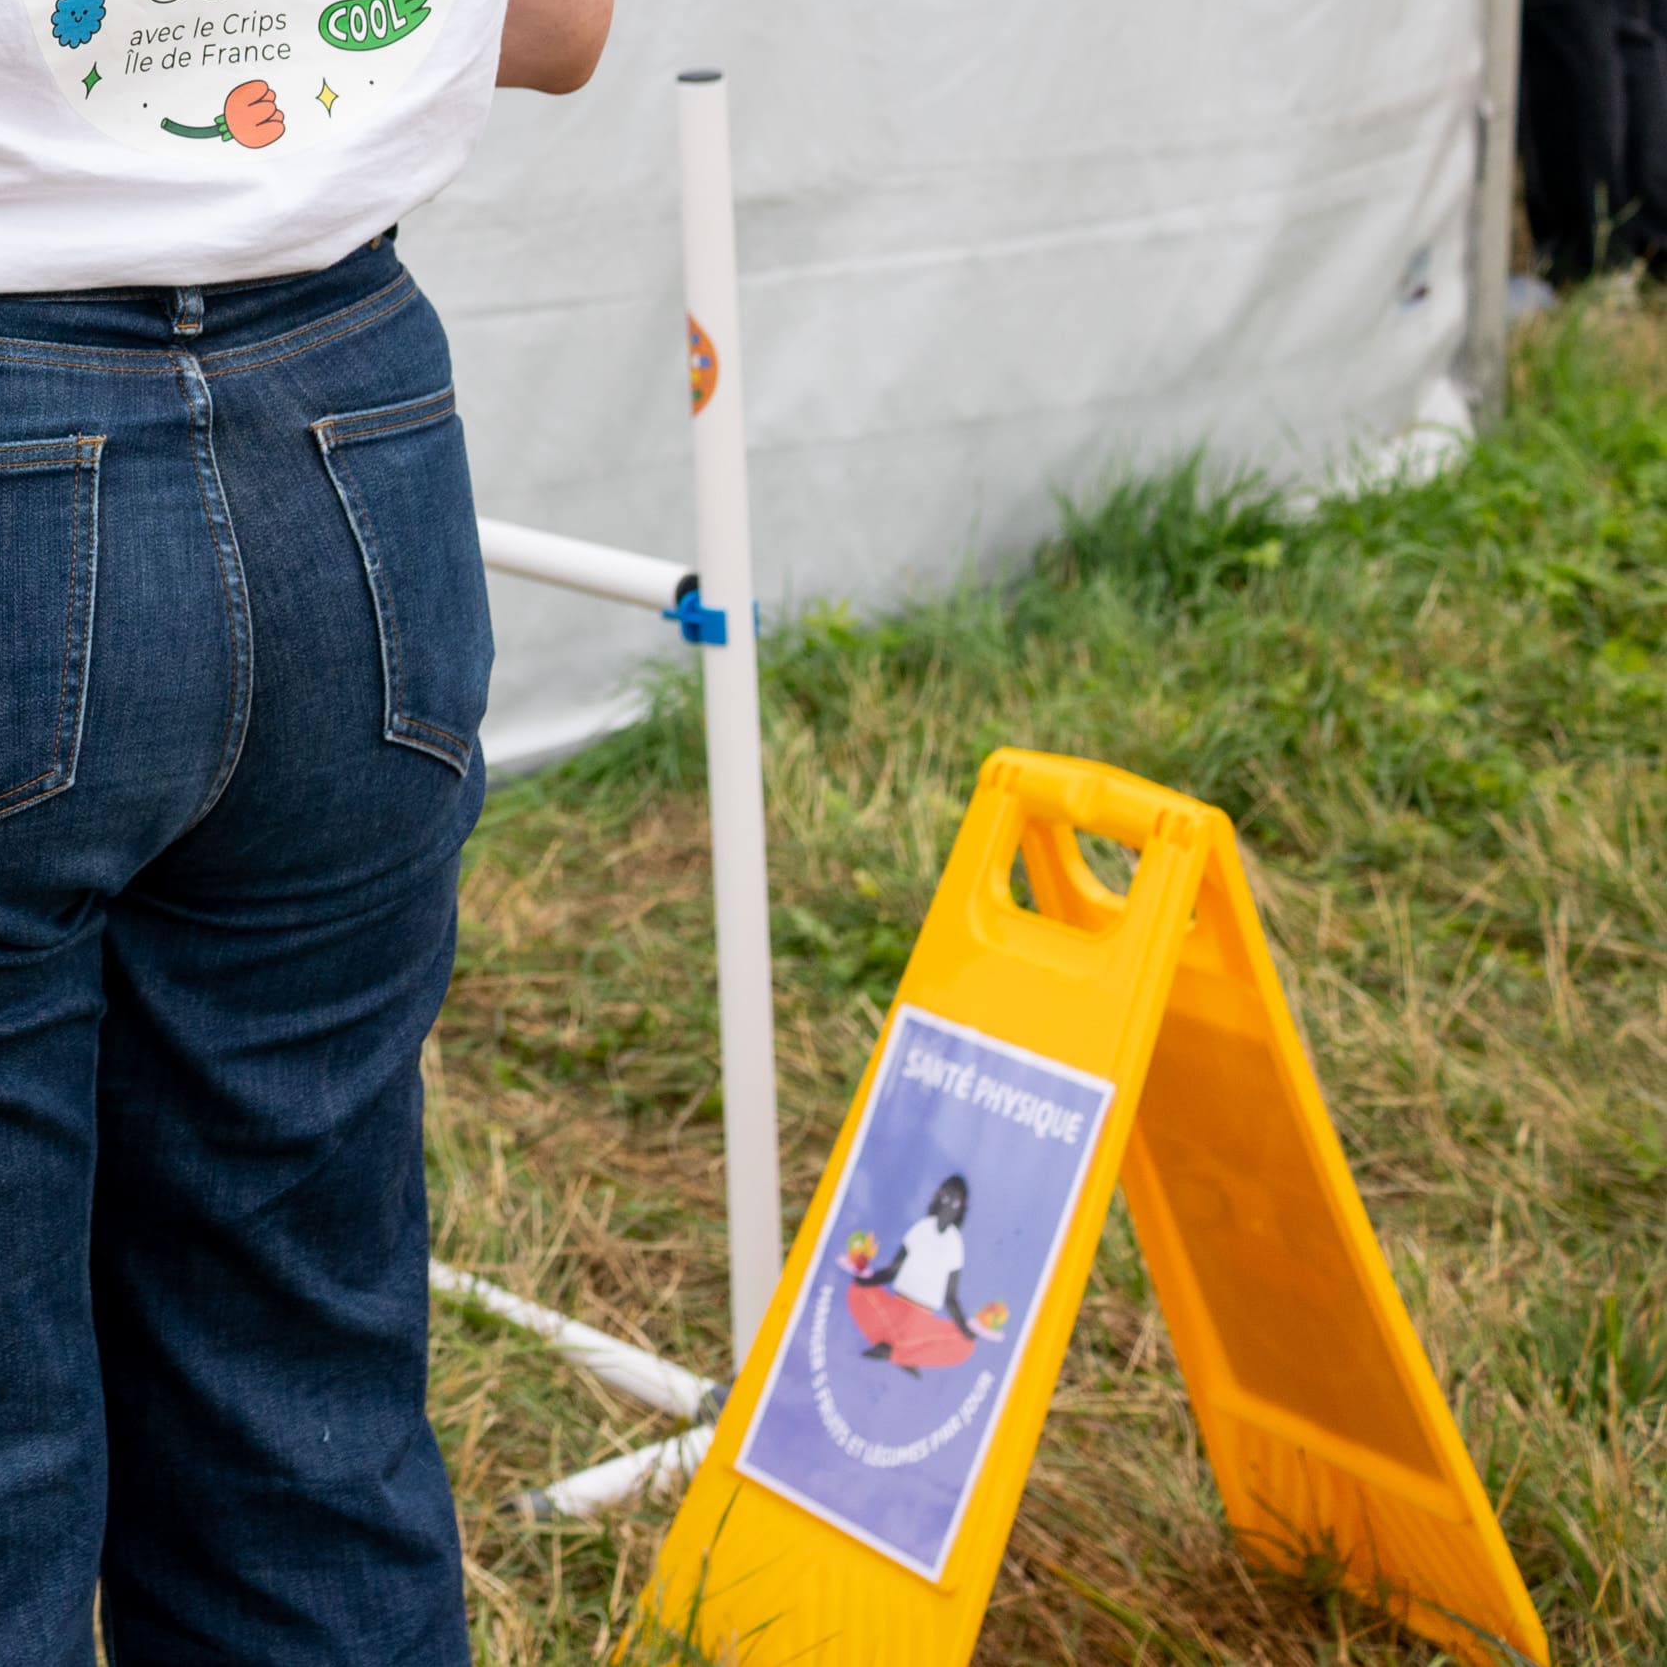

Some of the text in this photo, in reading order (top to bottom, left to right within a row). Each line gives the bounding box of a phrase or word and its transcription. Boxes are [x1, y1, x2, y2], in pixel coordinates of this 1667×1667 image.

[129, 9, 288, 47] avec le Crips
[123, 41, 292, 76] Île de France
[900, 1046, 1085, 1146] SANTÉ PHYSIQUE
